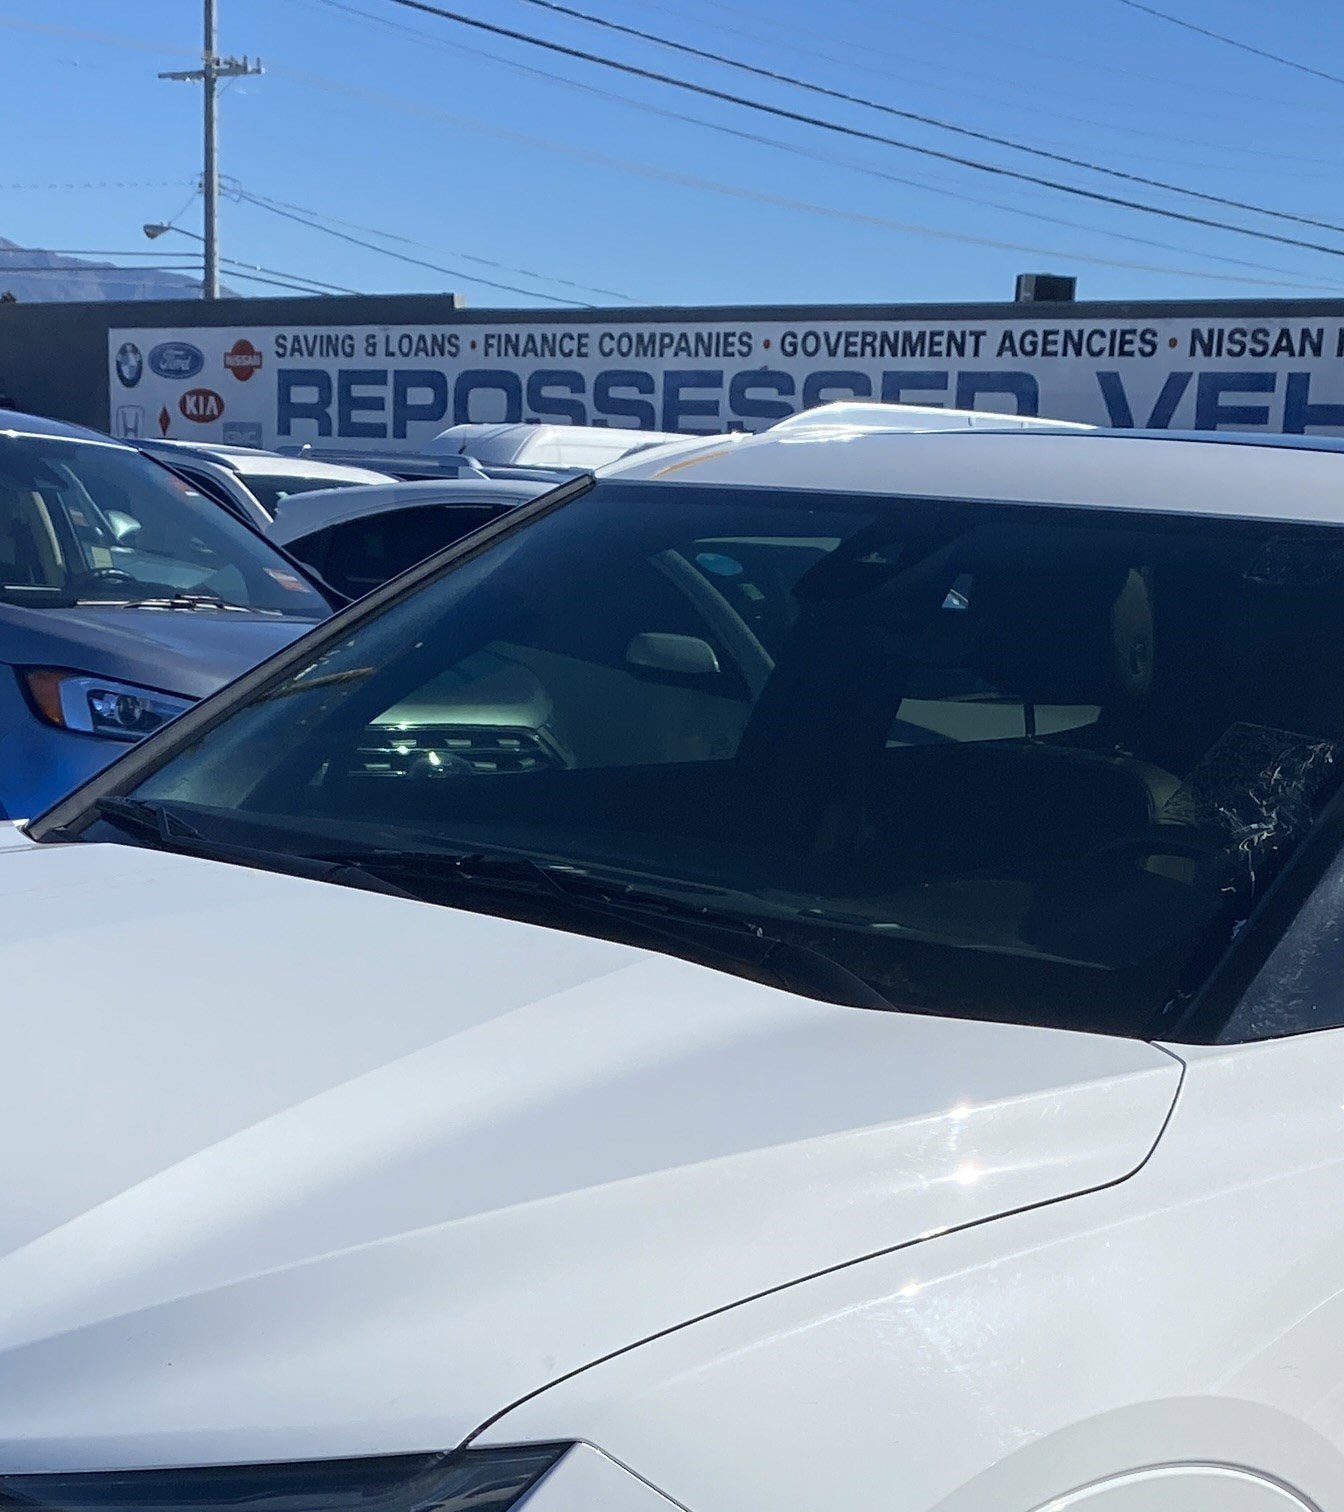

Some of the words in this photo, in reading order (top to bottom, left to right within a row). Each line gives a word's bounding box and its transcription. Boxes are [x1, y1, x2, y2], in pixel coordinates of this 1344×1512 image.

[274, 333, 355, 358] SAVING
[364, 334, 377, 358] &
[384, 333, 461, 358] LOANS
[483, 332, 589, 358] FINANCE
[598, 331, 753, 358] COMPANIES
[780, 330, 987, 358] GOVERNMENT
[996, 328, 1158, 358] AGENCIES
[1188, 327, 1324, 358] NISSAN
[185, 394, 219, 416] KIA
